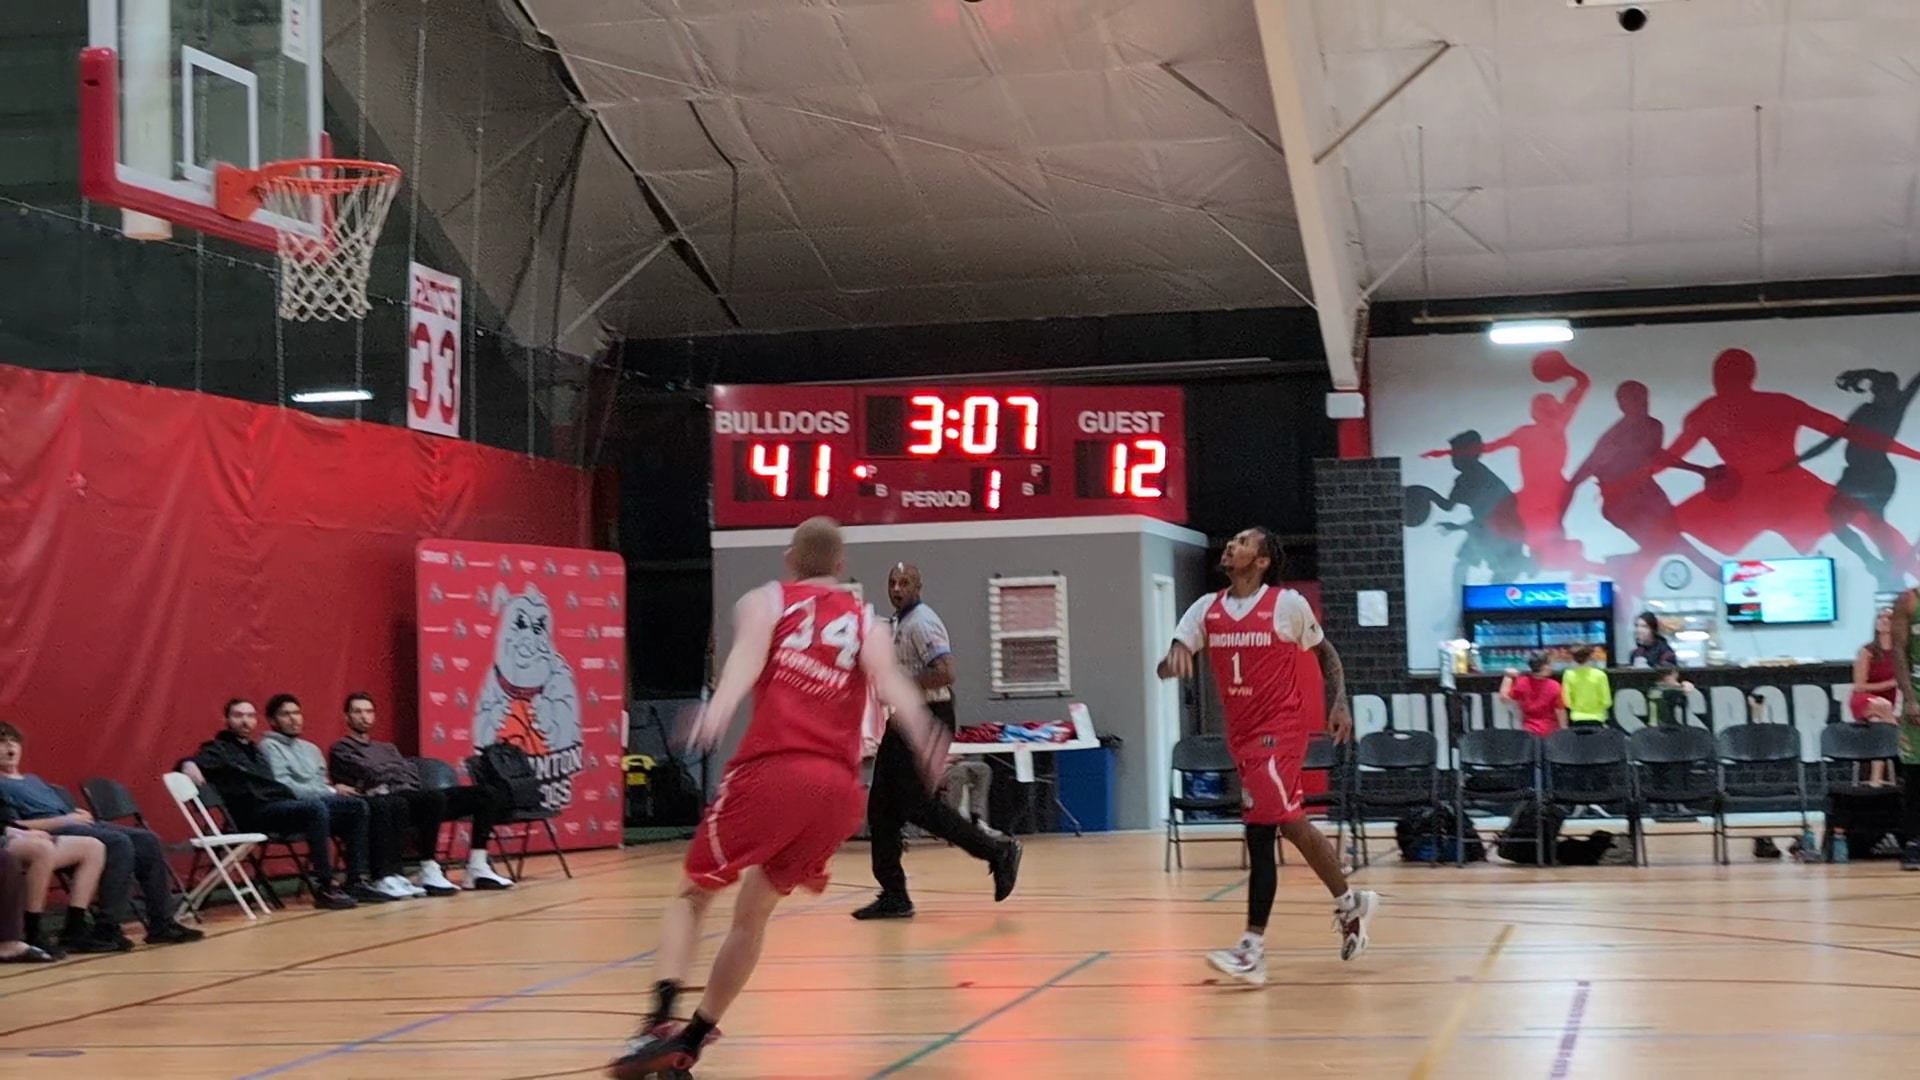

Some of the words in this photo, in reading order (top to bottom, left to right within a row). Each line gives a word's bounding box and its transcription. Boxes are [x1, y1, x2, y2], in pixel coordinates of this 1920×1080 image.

[408, 322, 456, 426] 33
[714, 410, 850, 434] BULLDOGS
[908, 395, 1039, 454] 3:07
[1077, 410, 1165, 434] GUEST
[752, 443, 832, 498] 41
[986, 469, 1001, 510] 1
[1112, 440, 1166, 498] 12
[901, 490, 971, 508] PERIOD
[1231, 651, 1243, 685] 1
